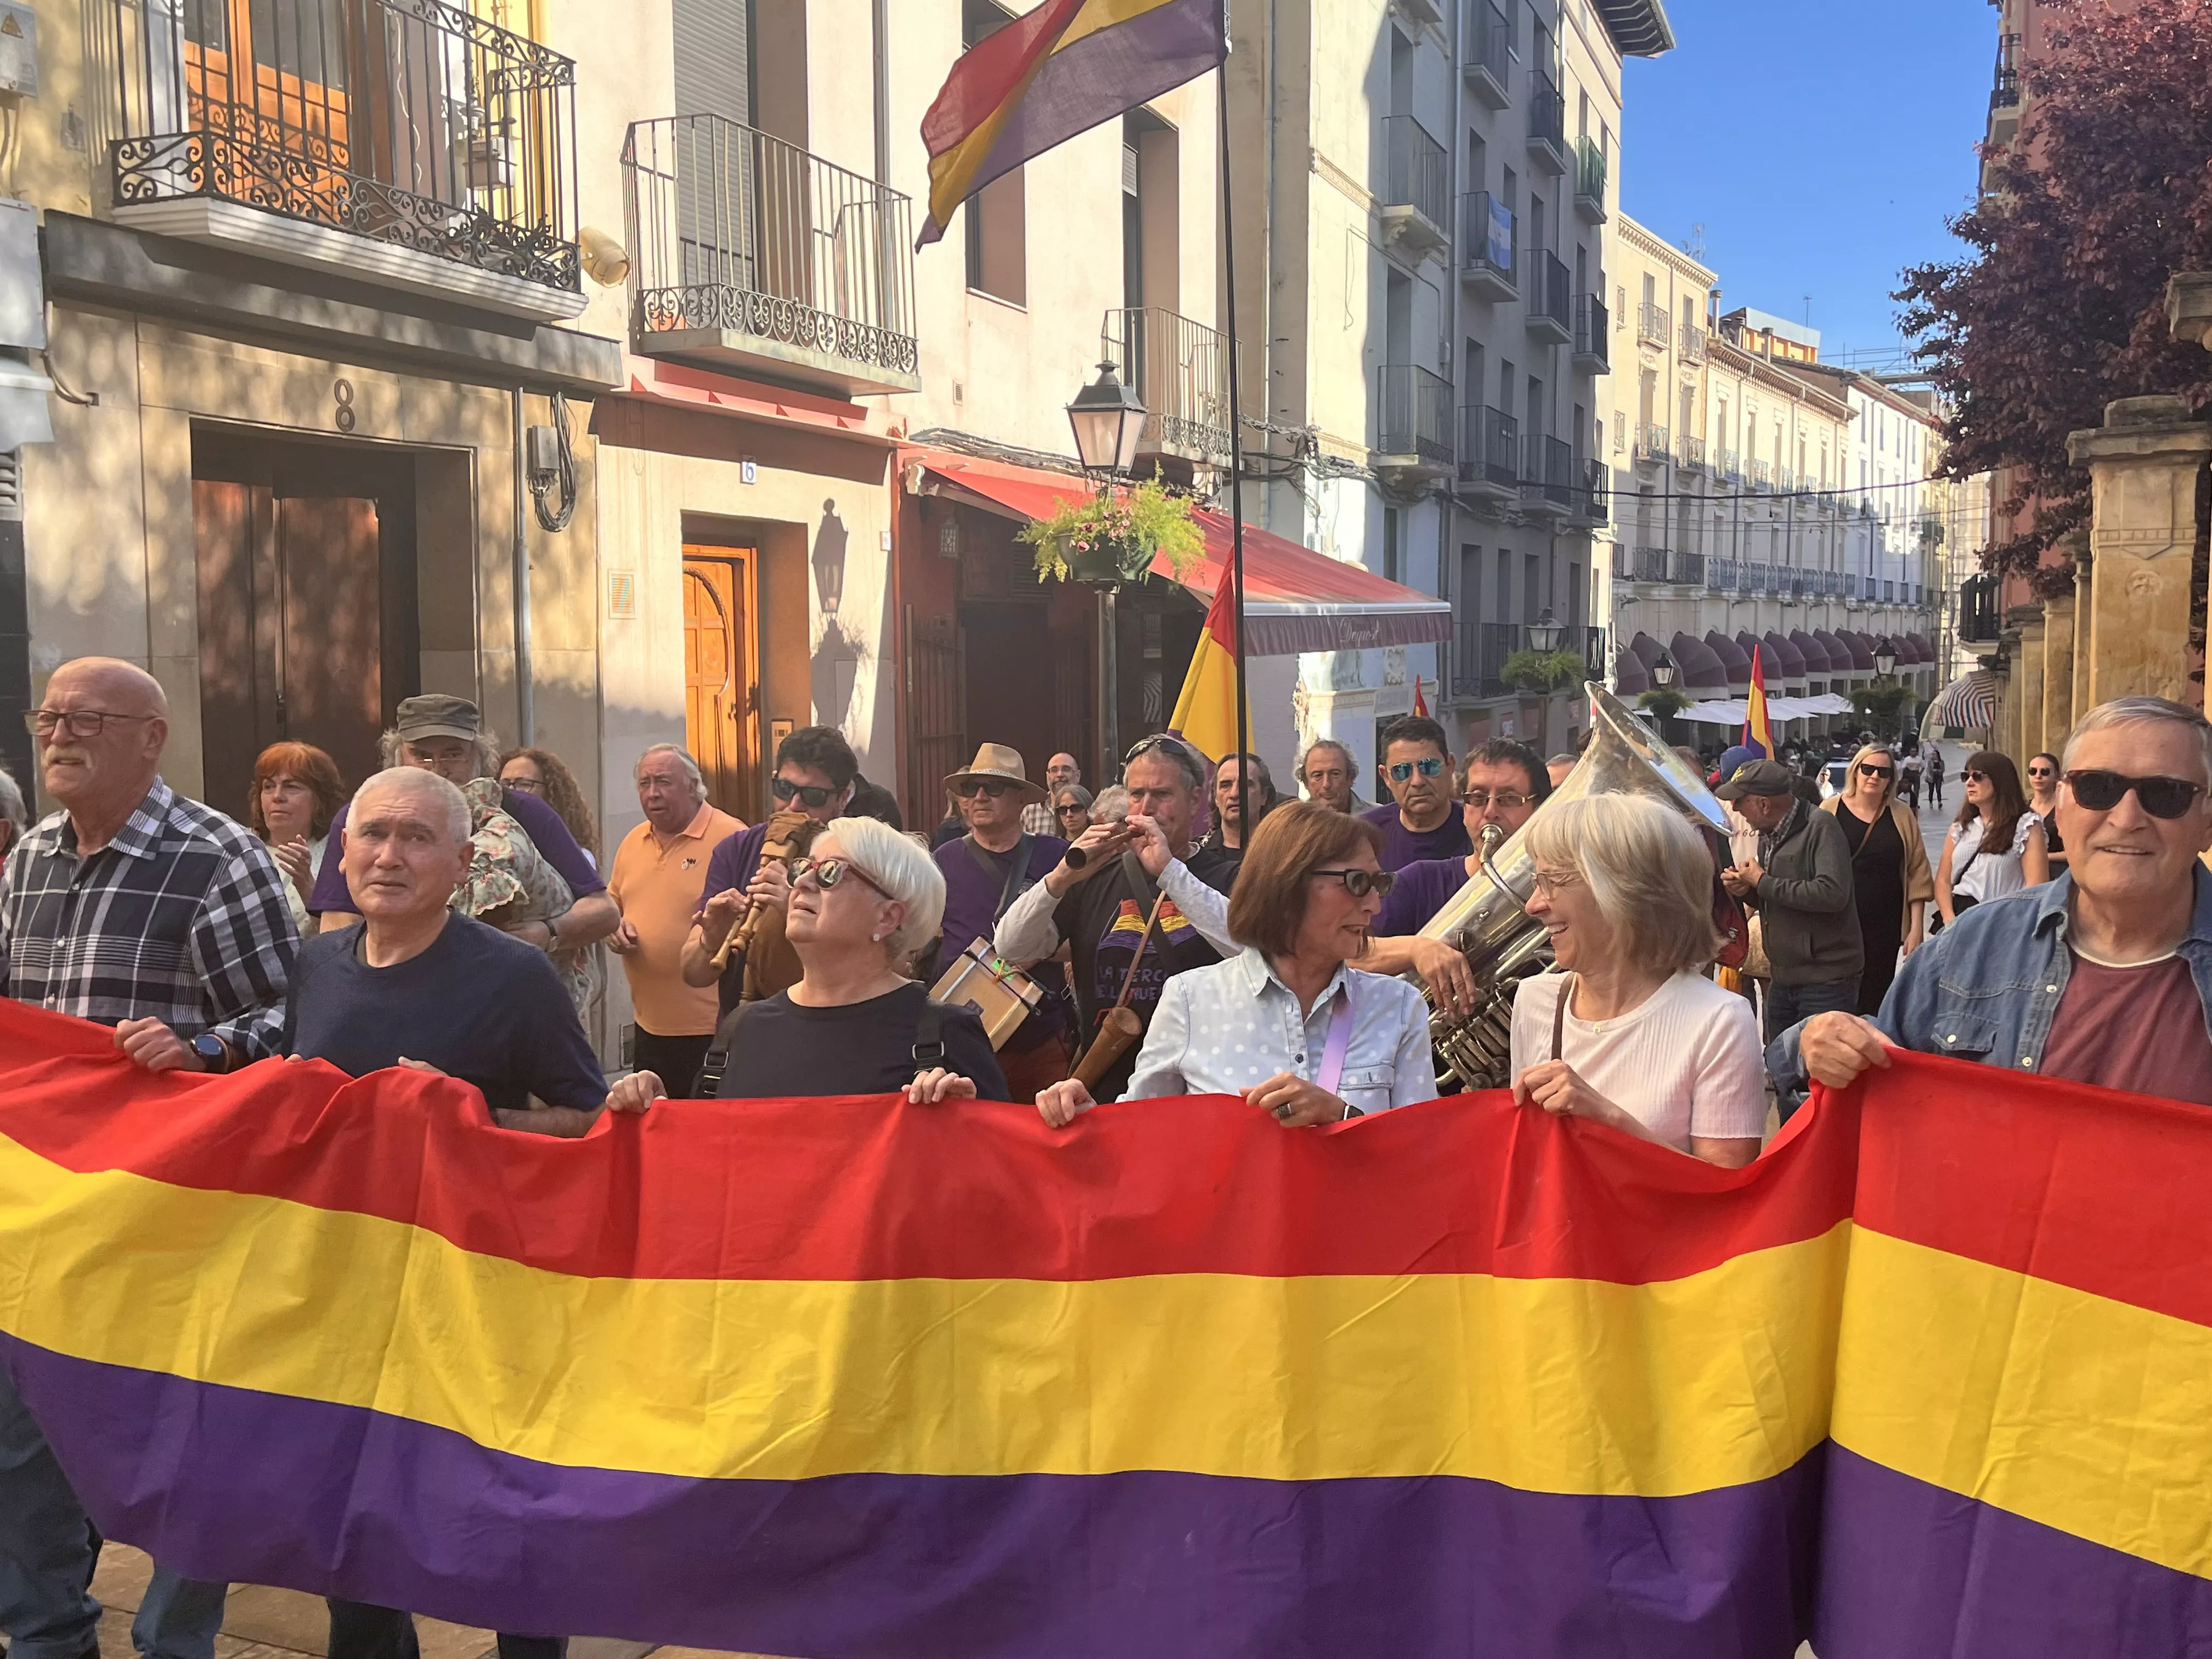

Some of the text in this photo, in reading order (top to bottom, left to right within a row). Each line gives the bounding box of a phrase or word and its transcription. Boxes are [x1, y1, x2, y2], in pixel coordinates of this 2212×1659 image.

[334, 379, 355, 432] 8
[746, 457, 754, 481] 6
[1119, 967, 1168, 983] TERC
